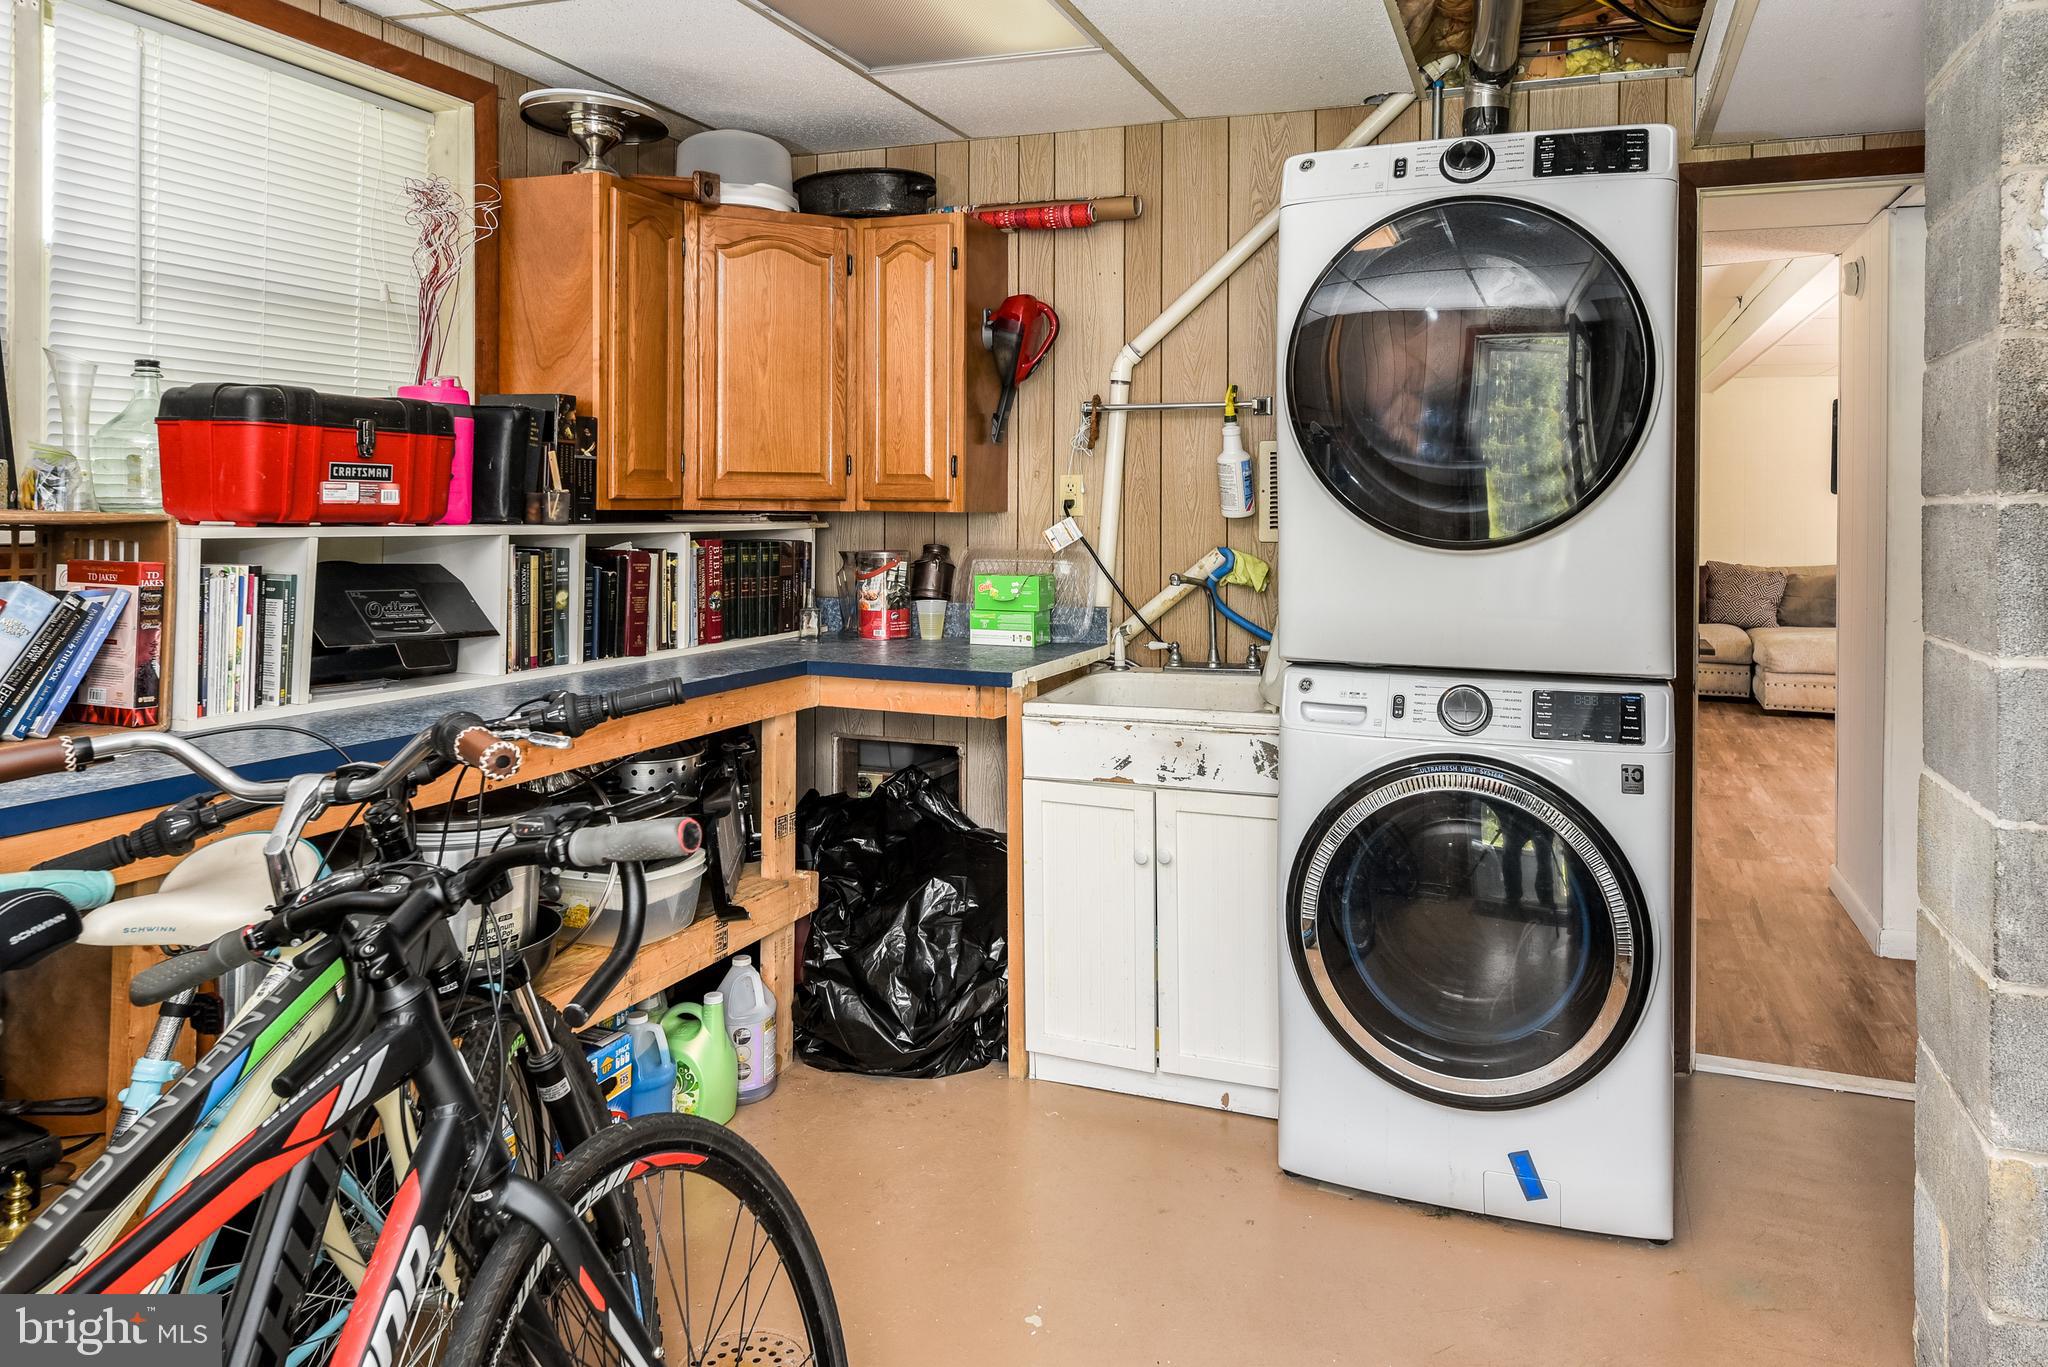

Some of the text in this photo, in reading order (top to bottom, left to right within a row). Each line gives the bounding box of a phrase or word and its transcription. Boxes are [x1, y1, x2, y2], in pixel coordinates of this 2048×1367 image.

[332, 466, 389, 478] CRAFTSMAN
[146, 571, 160, 579] TD
[71, 608, 99, 645] PARENTING
[26, 644, 40, 660] MAN
[30, 639, 50, 664] WOMAN
[60, 648, 74, 664] THE
[48, 662, 65, 683] BOOK
[1419, 764, 1458, 774] ULTRAFRESH
[1460, 765, 1477, 774] VENT
[9, 912, 67, 945] SCHWINN
[122, 926, 177, 934] SCHWINN
[602, 1063, 612, 1075] UP
